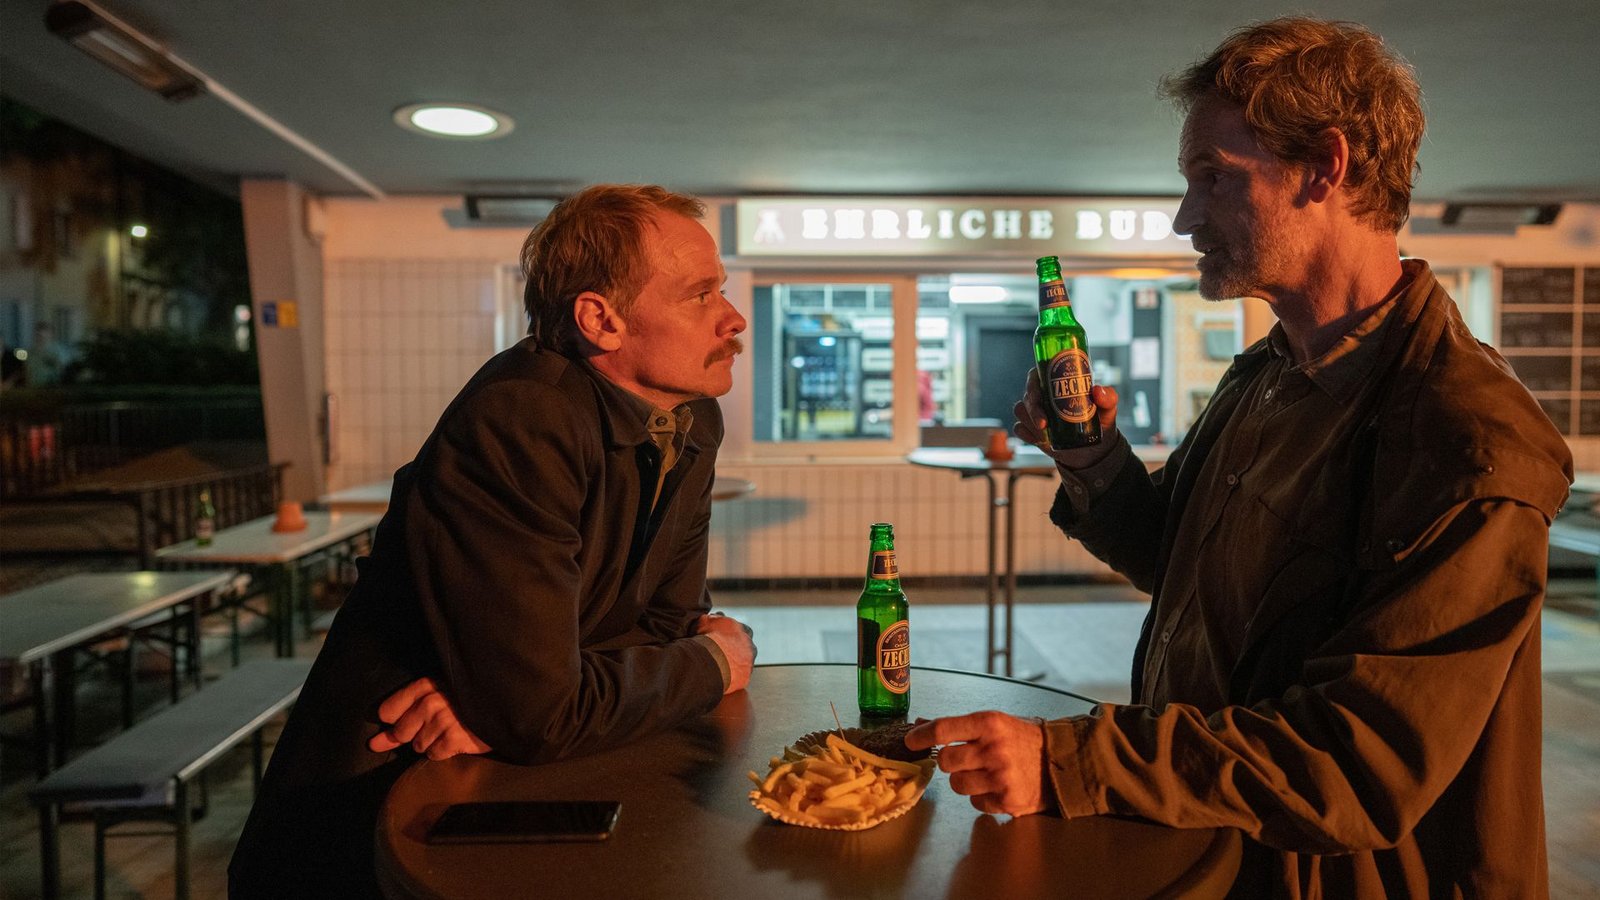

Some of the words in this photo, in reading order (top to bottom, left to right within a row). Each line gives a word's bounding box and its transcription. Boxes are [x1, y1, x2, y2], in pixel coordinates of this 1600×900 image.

[801, 209, 1054, 240] EHRLICHE
[1075, 209, 1192, 241] BUD
[883, 648, 910, 667] ZECH
